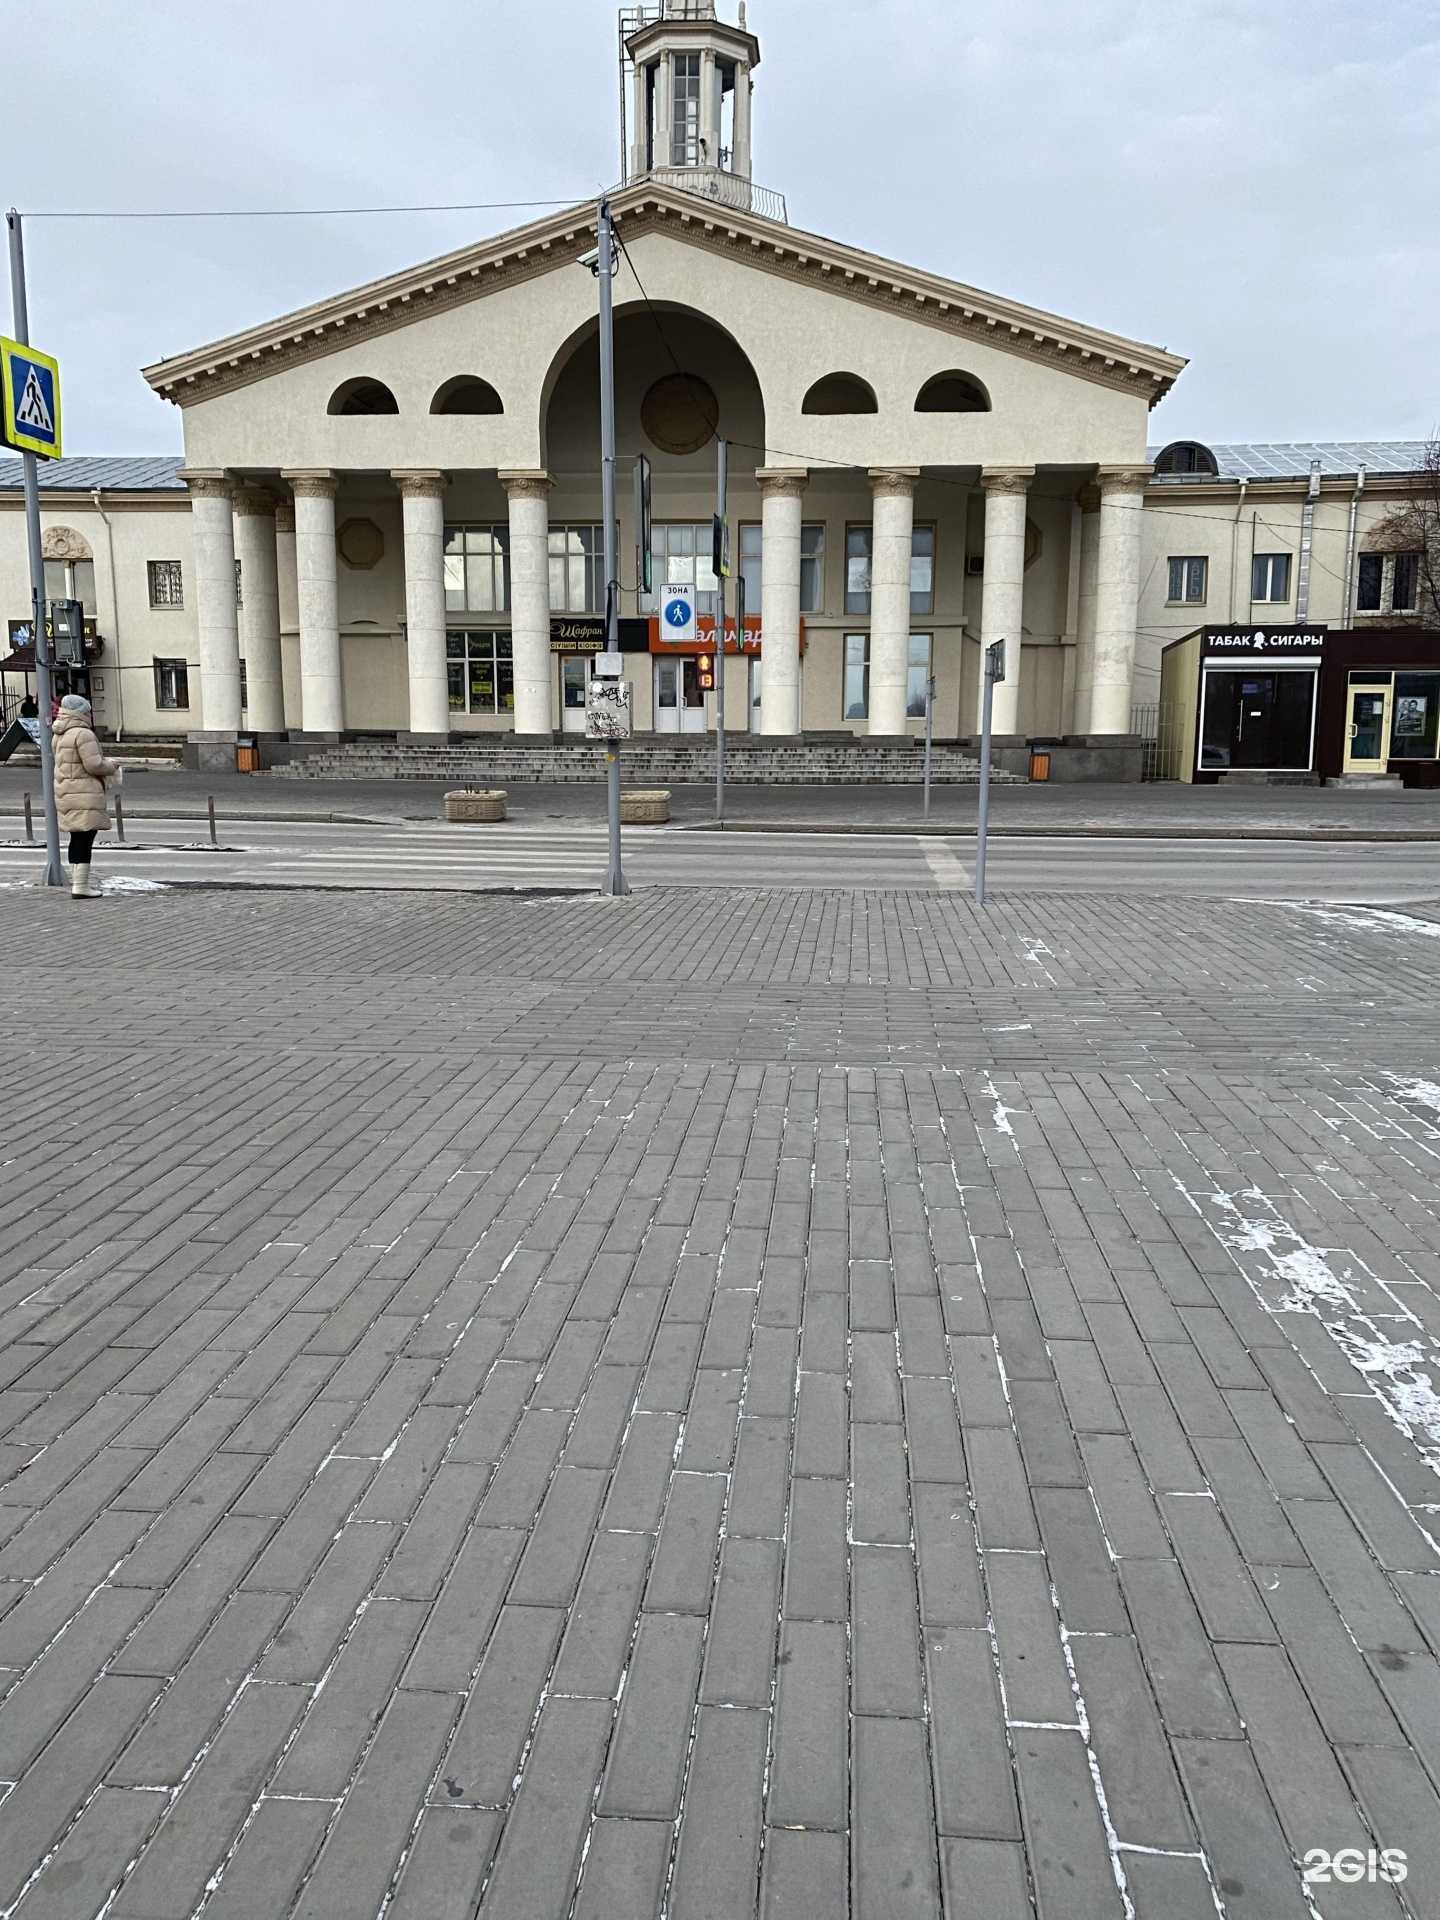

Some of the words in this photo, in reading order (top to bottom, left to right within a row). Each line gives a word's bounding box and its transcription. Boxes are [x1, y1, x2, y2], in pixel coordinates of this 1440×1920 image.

[667, 586, 689, 594] ЗОНА
[560, 622, 603, 639] Шафран
[1208, 635, 1251, 646] ТАБАК
[1270, 635, 1323, 646] СИГАРЫ
[701, 674, 713, 688] 13
